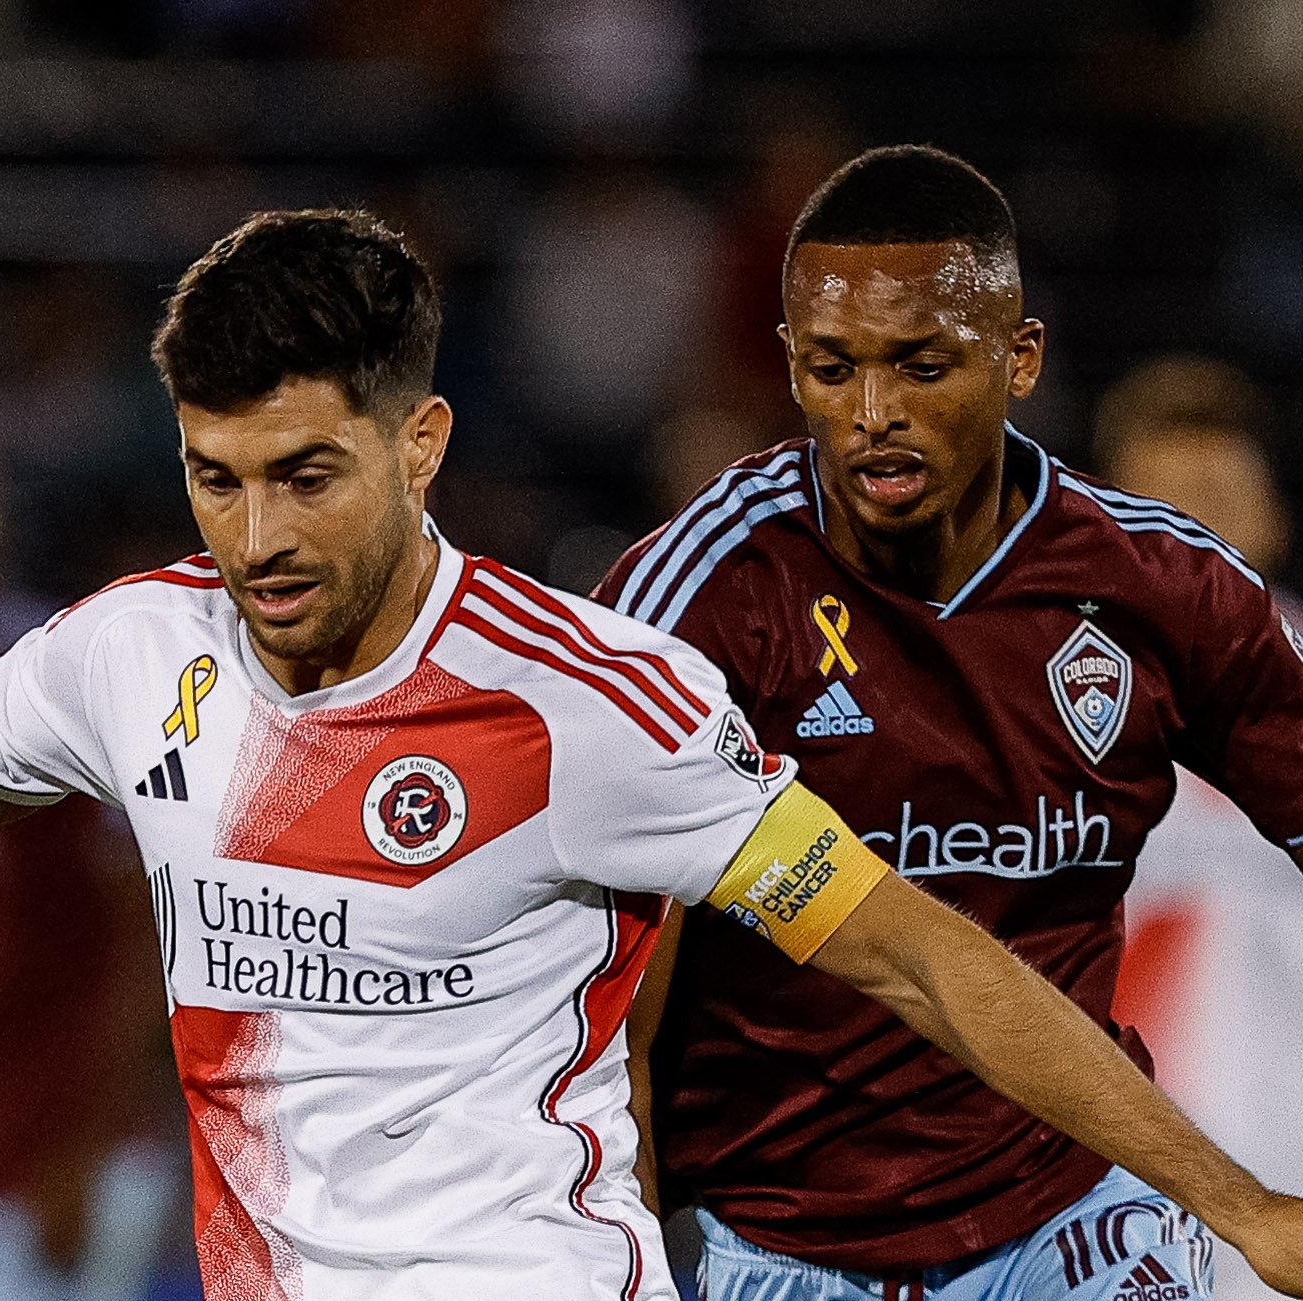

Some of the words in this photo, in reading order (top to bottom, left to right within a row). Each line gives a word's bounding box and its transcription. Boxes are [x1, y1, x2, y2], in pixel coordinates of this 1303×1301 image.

[723, 729, 742, 759] MLS
[797, 715, 875, 738] adidas
[383, 763, 406, 781] NEW
[409, 761, 456, 791] ENGLAND
[378, 838, 441, 860] REVOLUTION
[762, 828, 839, 913] CHILDHOOD
[744, 858, 789, 903] KICK
[777, 861, 838, 923] CANCER
[193, 878, 350, 950] United
[201, 937, 474, 1005] Healthcare
